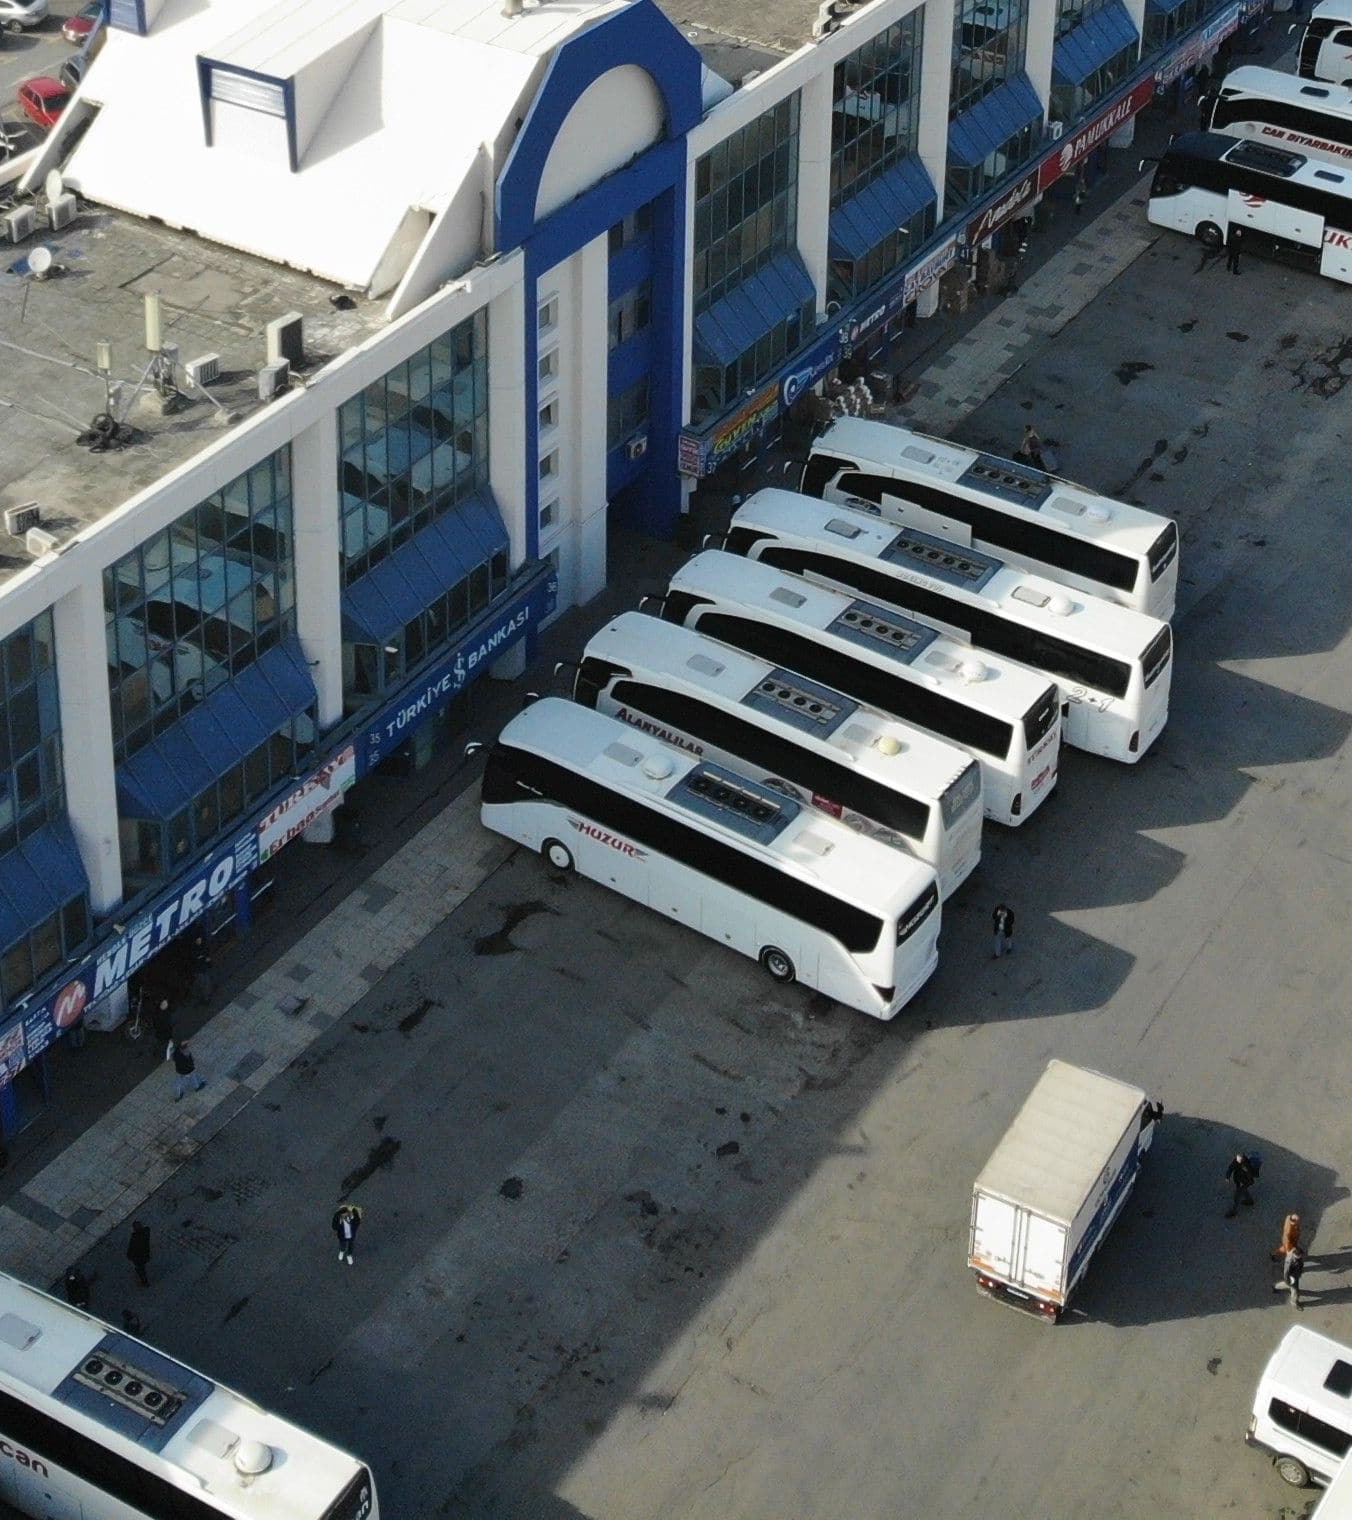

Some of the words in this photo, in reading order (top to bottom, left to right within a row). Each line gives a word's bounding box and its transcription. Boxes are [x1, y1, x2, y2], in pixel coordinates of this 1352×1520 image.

[1072, 96, 1133, 158] PAMUKKALE
[386, 673, 453, 738] TÜRKİYE
[468, 606, 530, 669] BANKASI
[369, 732, 382, 745] 35
[615, 707, 704, 757] ALANYALILAR
[577, 822, 636, 857] HUZUR
[93, 856, 236, 999] METRO
